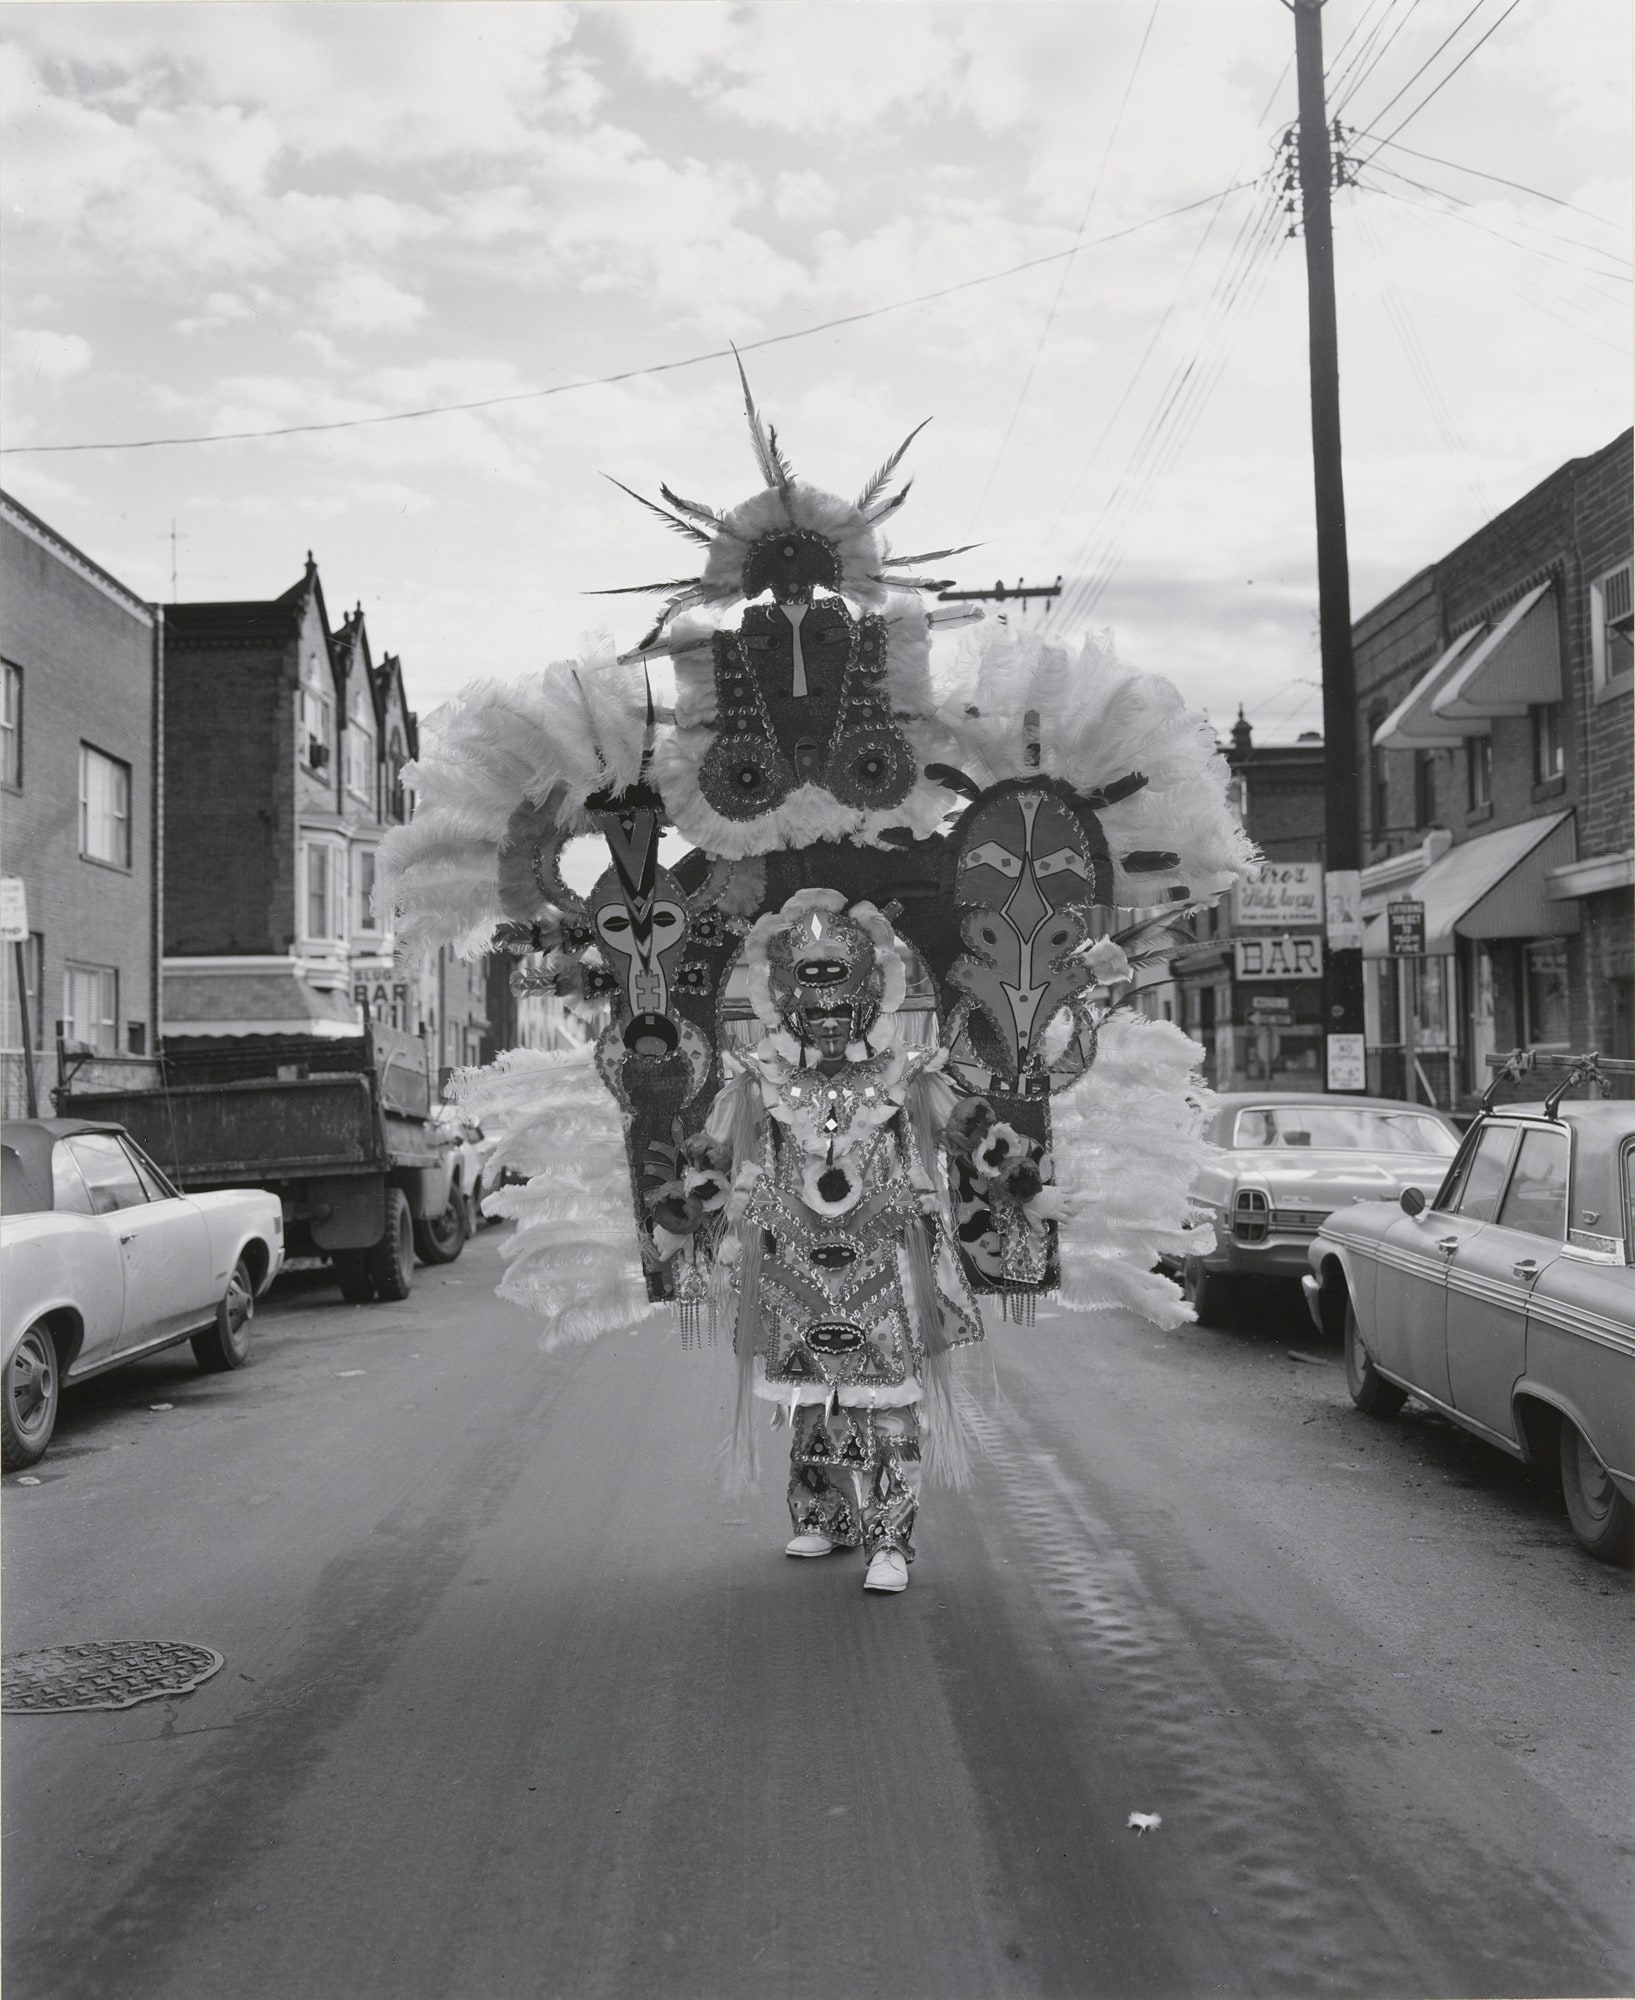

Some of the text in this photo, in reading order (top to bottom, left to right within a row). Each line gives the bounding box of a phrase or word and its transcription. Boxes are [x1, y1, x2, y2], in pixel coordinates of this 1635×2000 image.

[1395, 943, 1420, 953] FINE
[1242, 941, 1318, 974] BAR
[354, 984, 408, 1002] BAR
